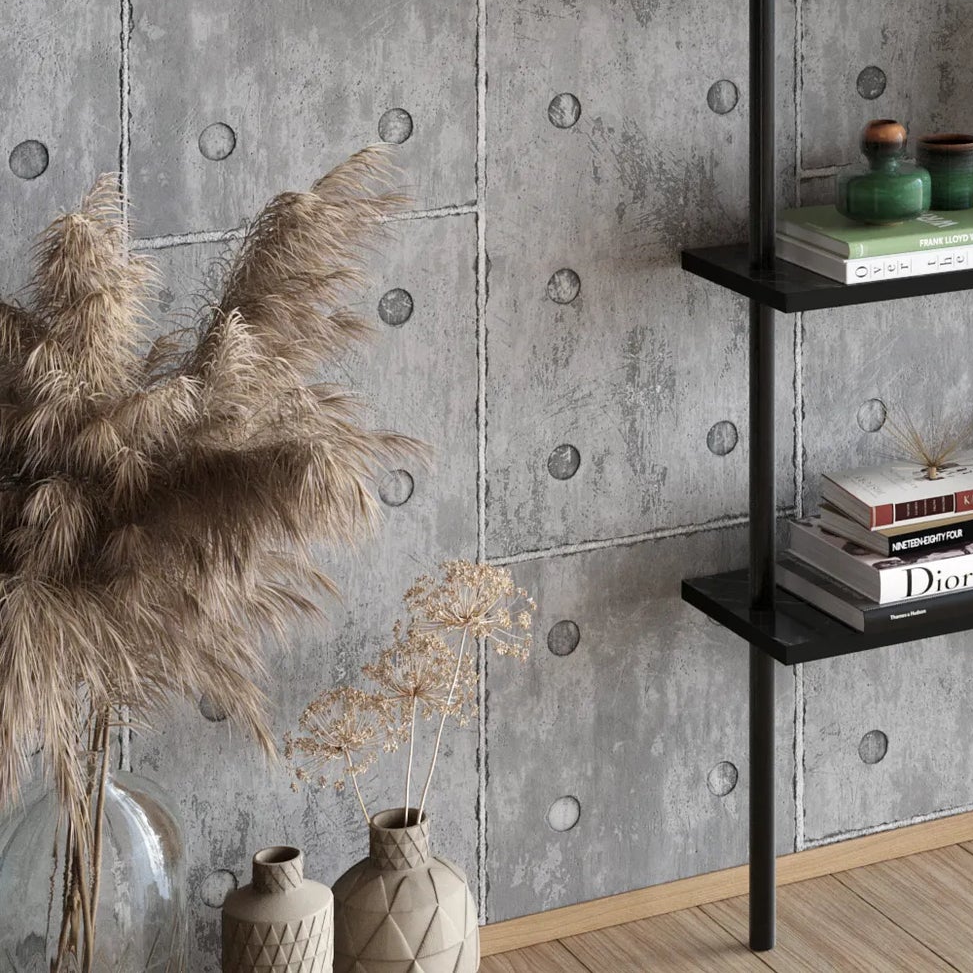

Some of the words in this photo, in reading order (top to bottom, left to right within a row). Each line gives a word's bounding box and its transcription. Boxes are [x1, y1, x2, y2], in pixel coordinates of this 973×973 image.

[919, 238, 944, 247] FRANK
[944, 234, 969, 245] LLOYD
[892, 531, 946, 552] NINETEEN-EIGHTY
[946, 529, 963, 542] FOUR
[901, 567, 973, 597] Dior
[911, 609, 927, 617] Hudson
